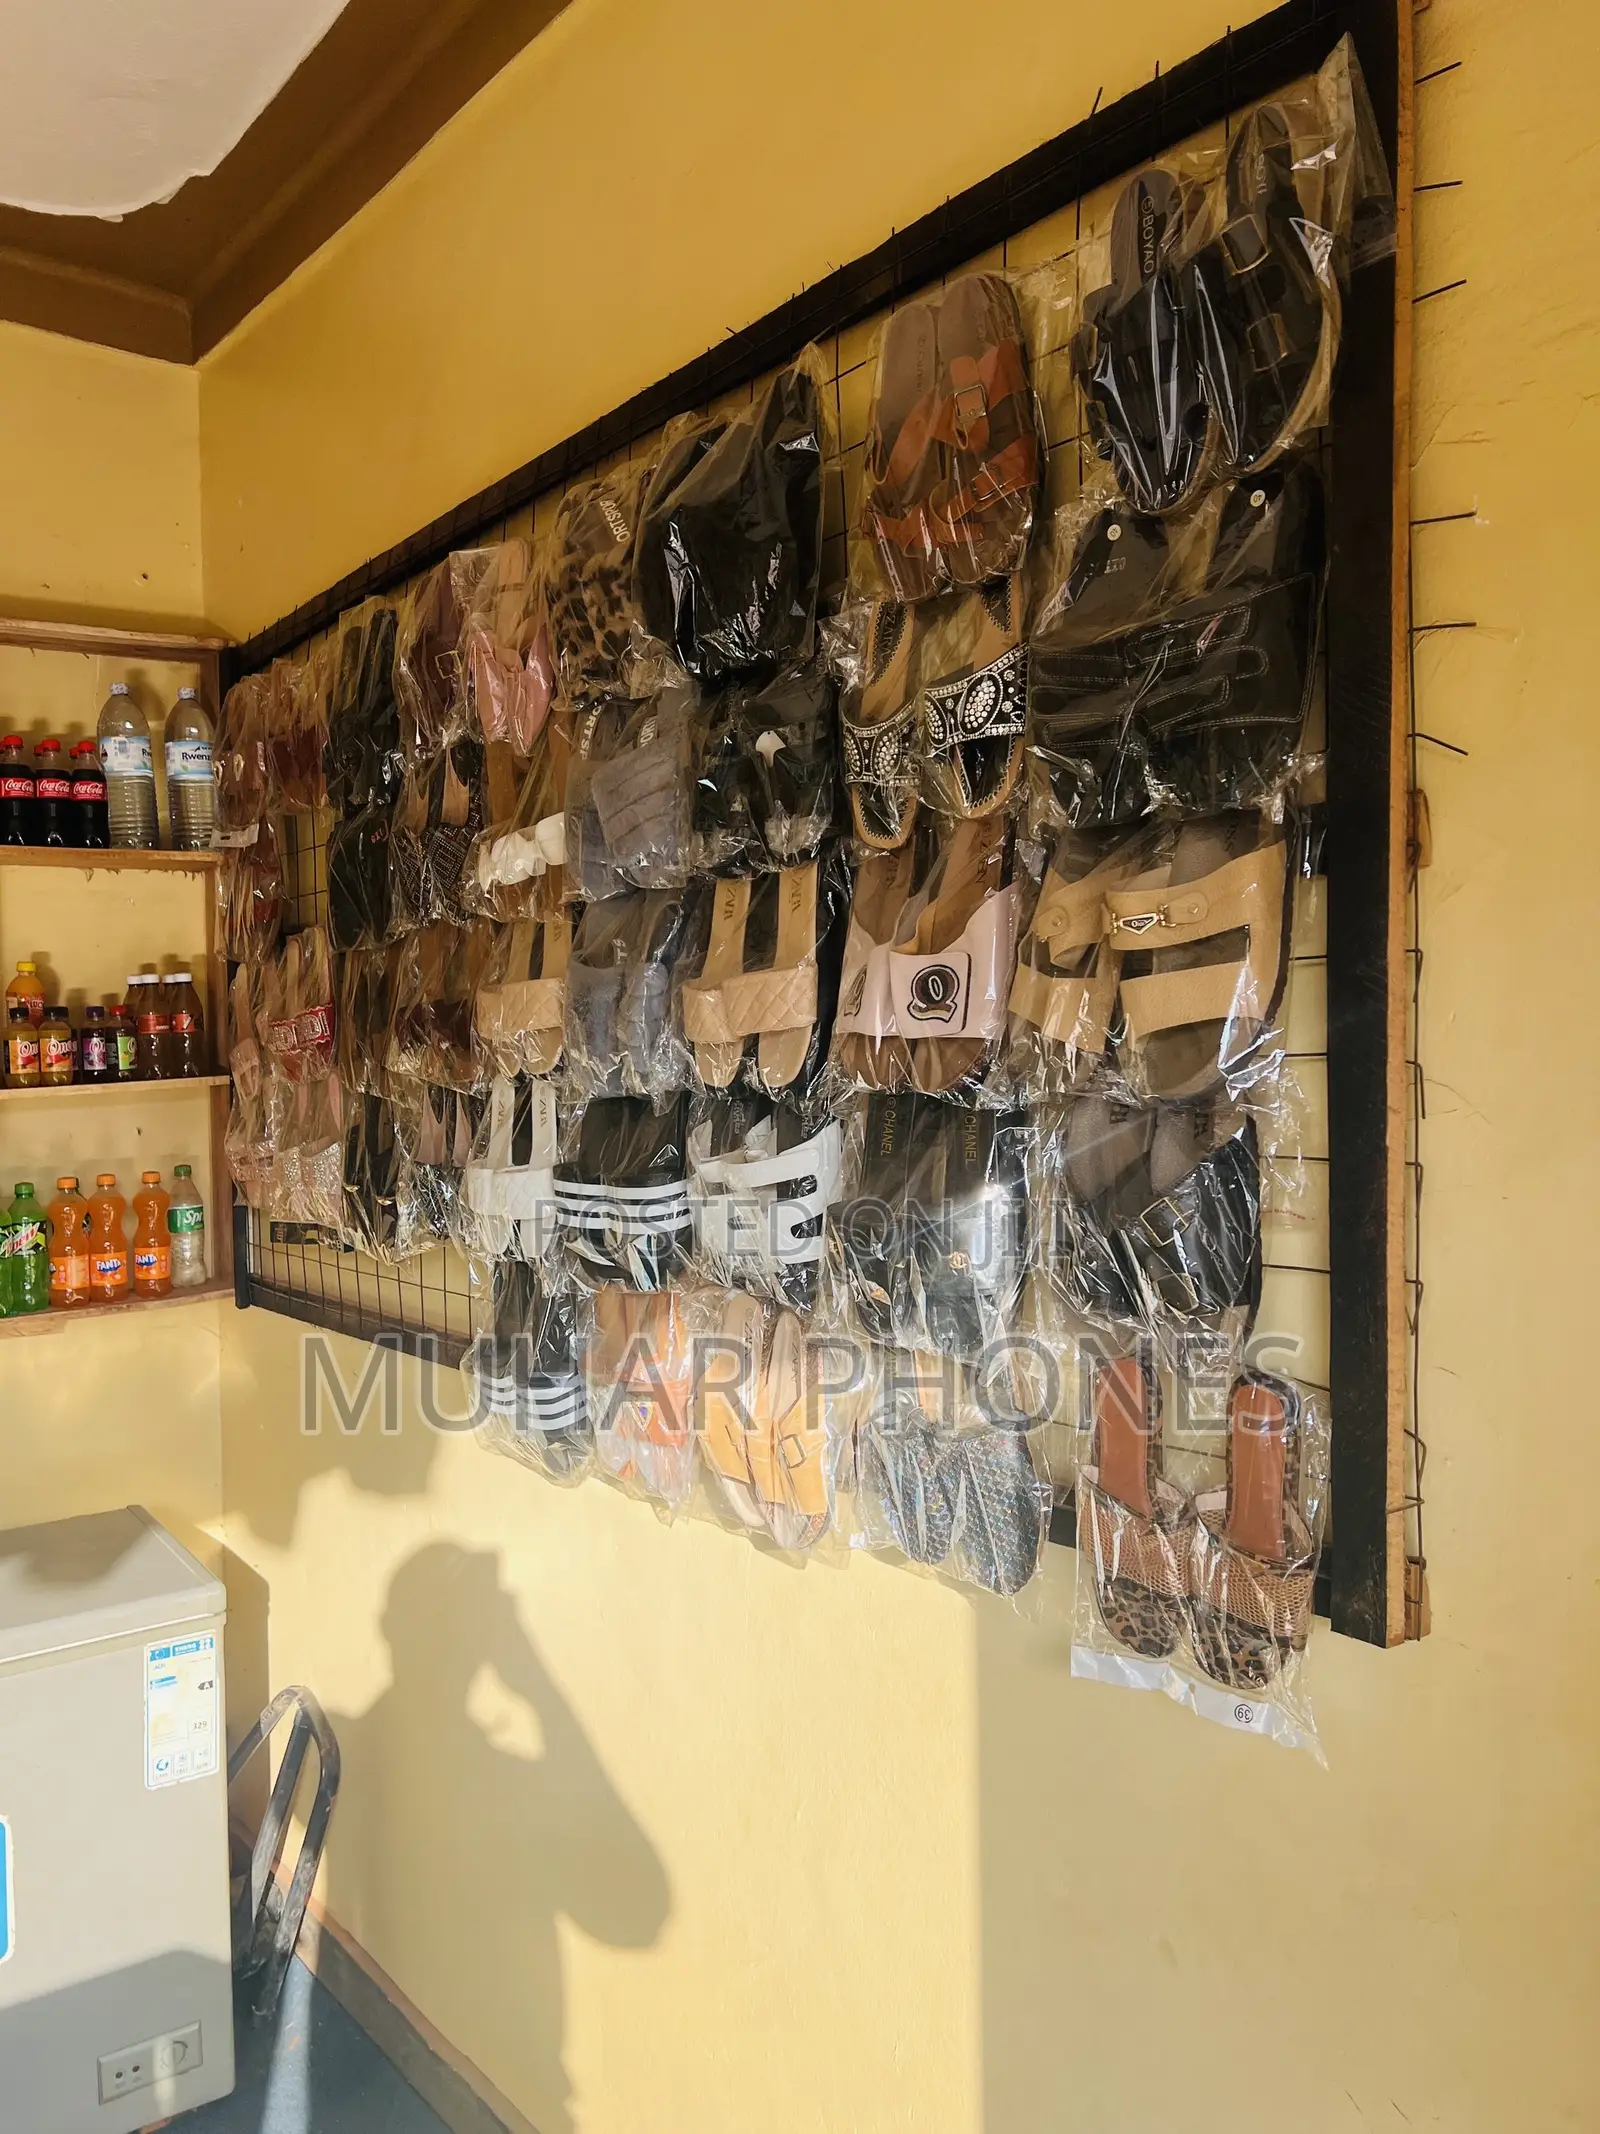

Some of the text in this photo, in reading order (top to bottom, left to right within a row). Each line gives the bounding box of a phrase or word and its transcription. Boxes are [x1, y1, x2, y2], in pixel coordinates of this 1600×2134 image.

[880, 1109, 896, 1156] CHANEL
[964, 1115, 978, 1165] CHANEL
[192, 1720, 208, 1731] 329
